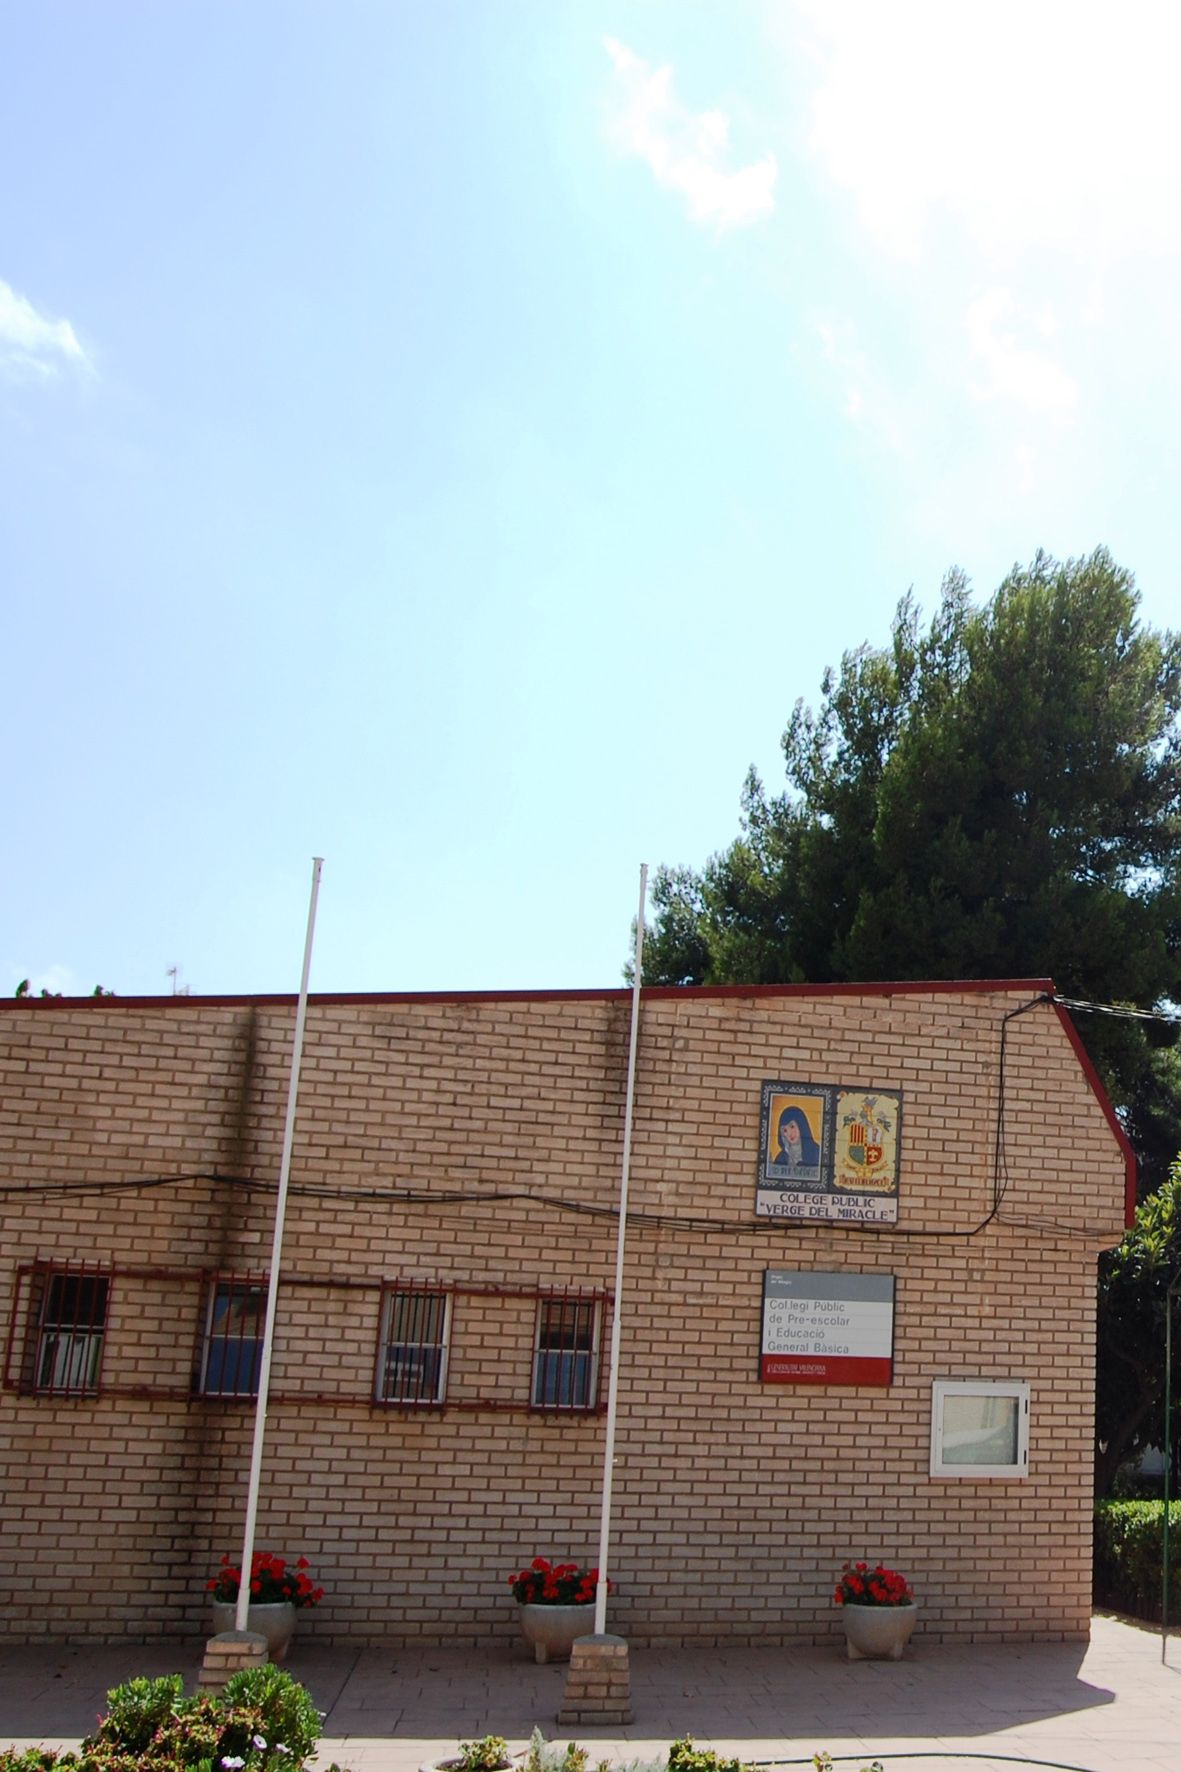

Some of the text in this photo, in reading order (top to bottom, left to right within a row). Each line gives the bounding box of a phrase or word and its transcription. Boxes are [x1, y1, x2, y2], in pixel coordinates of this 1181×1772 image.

[780, 1193, 876, 1208] COLEGE PUBLIC
[809, 1206, 833, 1218] DEL
[769, 1313, 850, 1326] de Pre-escolar
[776, 1327, 825, 1339] Educació
[767, 1340, 809, 1352] General
